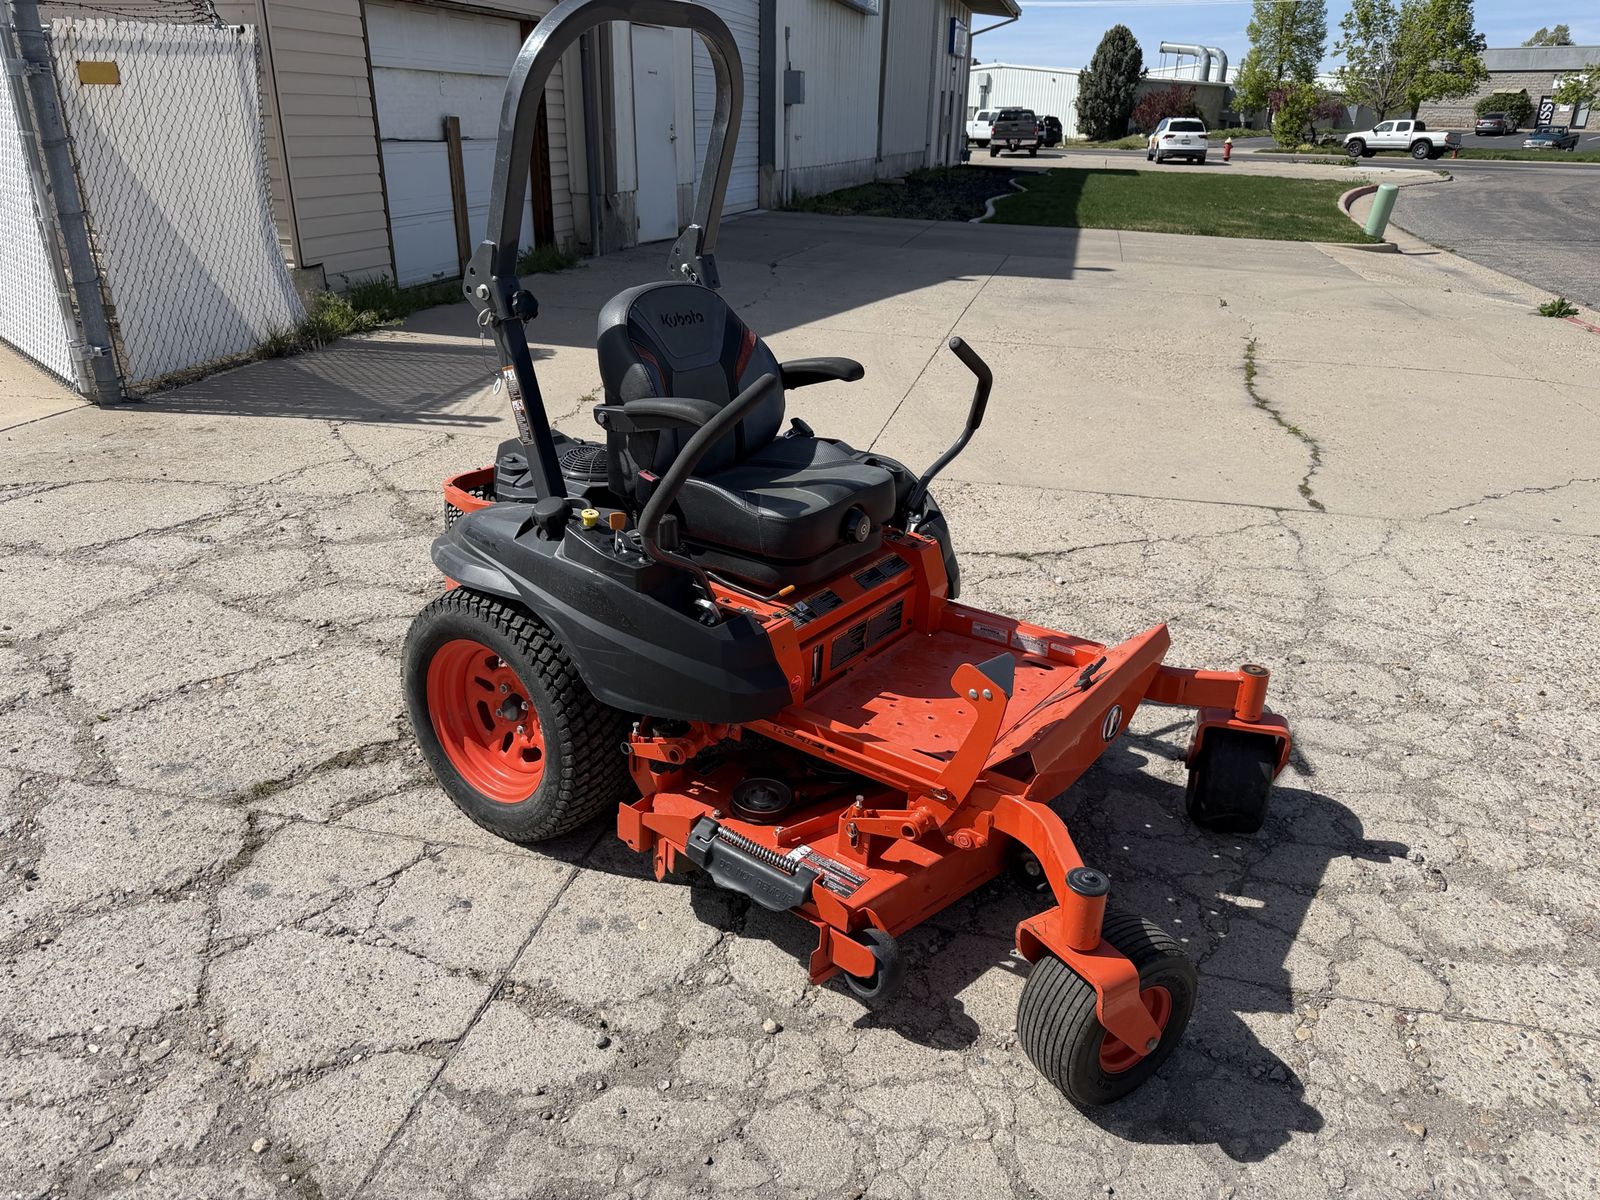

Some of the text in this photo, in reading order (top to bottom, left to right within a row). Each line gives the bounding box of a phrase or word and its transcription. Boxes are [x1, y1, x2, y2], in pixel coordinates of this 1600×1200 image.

[661, 310, 704, 328] Kubota
[736, 867, 754, 882] NOT
[757, 878, 794, 904] REMOVE
